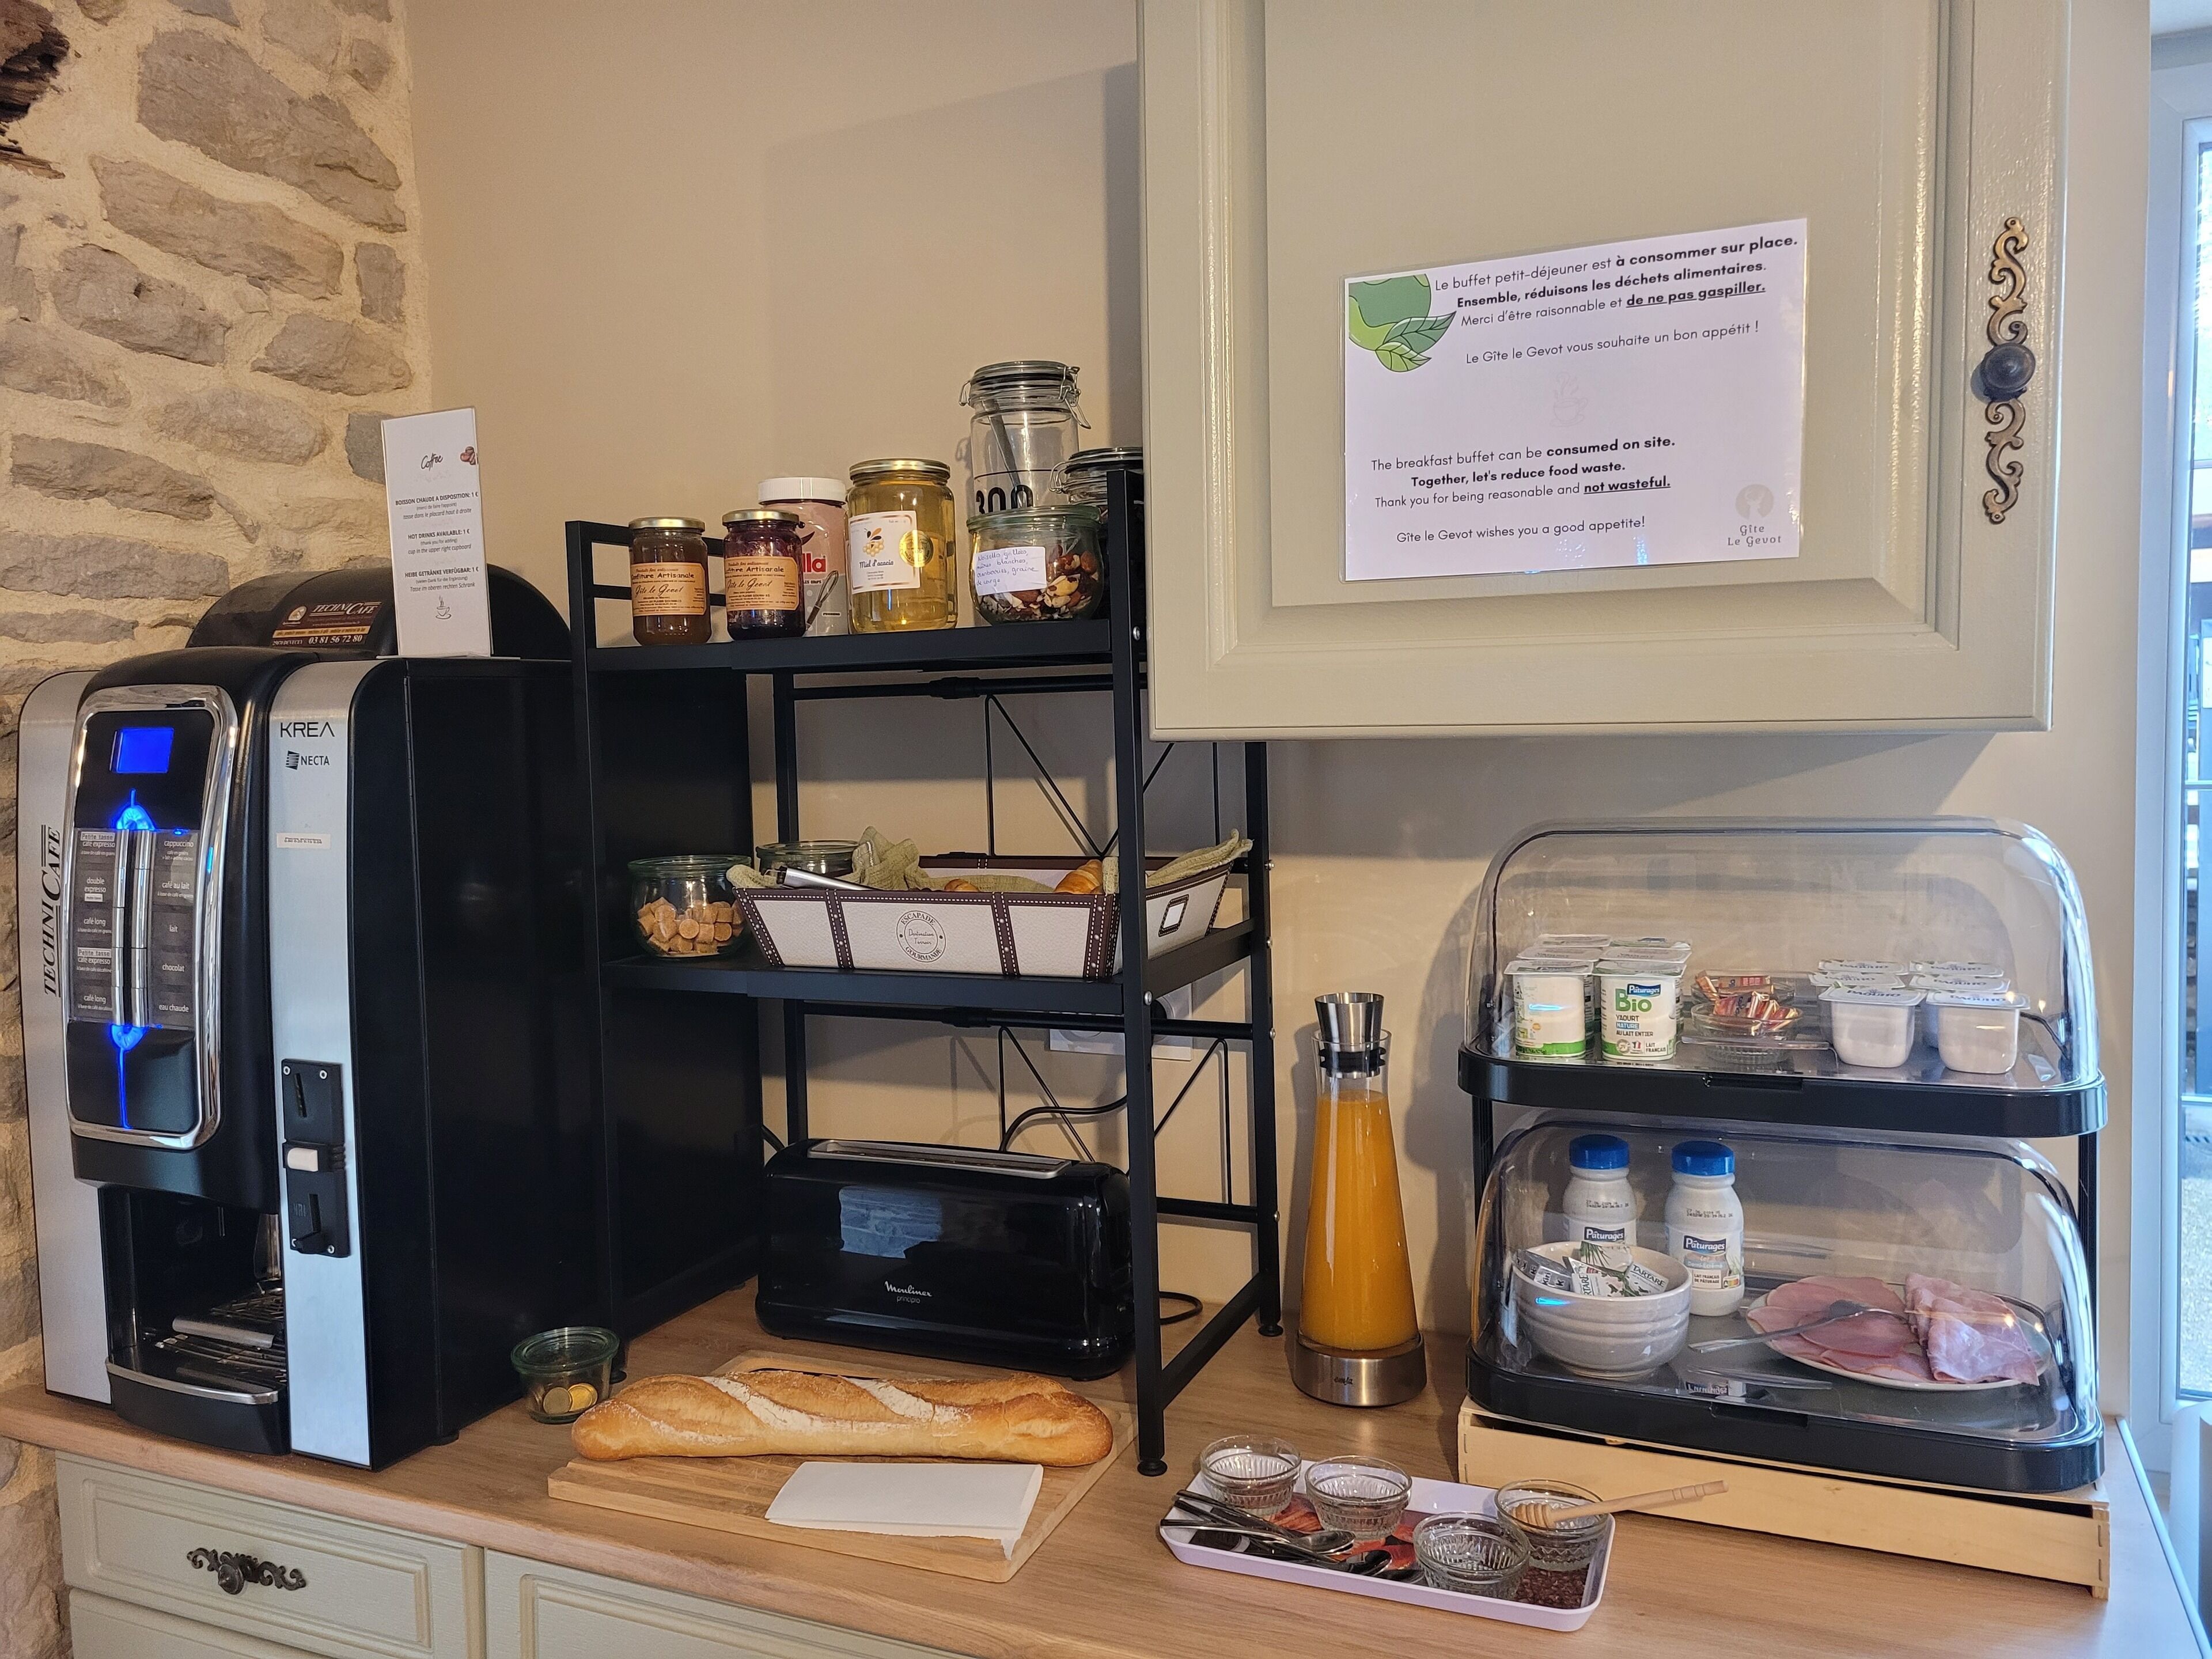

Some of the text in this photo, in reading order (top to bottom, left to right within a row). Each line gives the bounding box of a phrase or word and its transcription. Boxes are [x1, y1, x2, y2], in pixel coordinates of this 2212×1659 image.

[1435, 236, 1798, 291] Le buffet petit-déjeuner est à consommer sur place.
[1457, 262, 1767, 308] Ensemble, réduisons les déchets alimentaires.
[1461, 313, 1494, 327] Merci
[1536, 298, 1606, 318] raisonnable
[1609, 297, 1622, 308] et
[1626, 294, 1647, 308] de
[1647, 295, 1665, 306] ne
[1668, 291, 1694, 305] pas
[1698, 281, 1766, 301] gaspiller.
[1466, 320, 1759, 364] Le Gîte le Gevot vous souhaite un bon appétit !
[1371, 436, 1675, 471] The breakfast buffet can be consumed on site.
[421, 453, 443, 471] Coffee
[1411, 461, 1626, 489] Together, let's reduce food waste.
[440, 493, 471, 501] DISPOSITION:
[1374, 475, 1671, 509] Thank you for being reasonable and not wasteful.
[1396, 532, 1421, 543] Gîte
[1425, 529, 1434, 541] le
[1438, 529, 1473, 540] Gevot
[1476, 525, 1514, 538] wishes
[1517, 527, 1538, 539] you
[1554, 520, 1585, 536] good
[1589, 516, 1645, 534] appetite!
[1740, 525, 1764, 536] Gîte
[1728, 536, 1781, 547] Le Gevot
[859, 559, 872, 569] Miel
[308, 637, 318, 645] 03
[301, 755, 330, 766] NECTA
[86, 877, 105, 885] double
[181, 882, 190, 890] lait
[94, 918, 106, 927] long
[900, 912, 936, 925] ESCAPADE
[906, 946, 942, 960] GOURMANDE
[162, 964, 184, 972] chocolat
[1628, 985, 1660, 995] Pâturages
[94, 995, 106, 1004] long
[1615, 988, 1652, 1012] Bio
[169, 1004, 189, 1013] chaude
[1585, 1229, 1624, 1241] Pâturages
[1685, 1238, 1725, 1252] Pâturages
[1632, 1264, 1666, 1288] TARTARE
[884, 1281, 933, 1297] Moulinex
